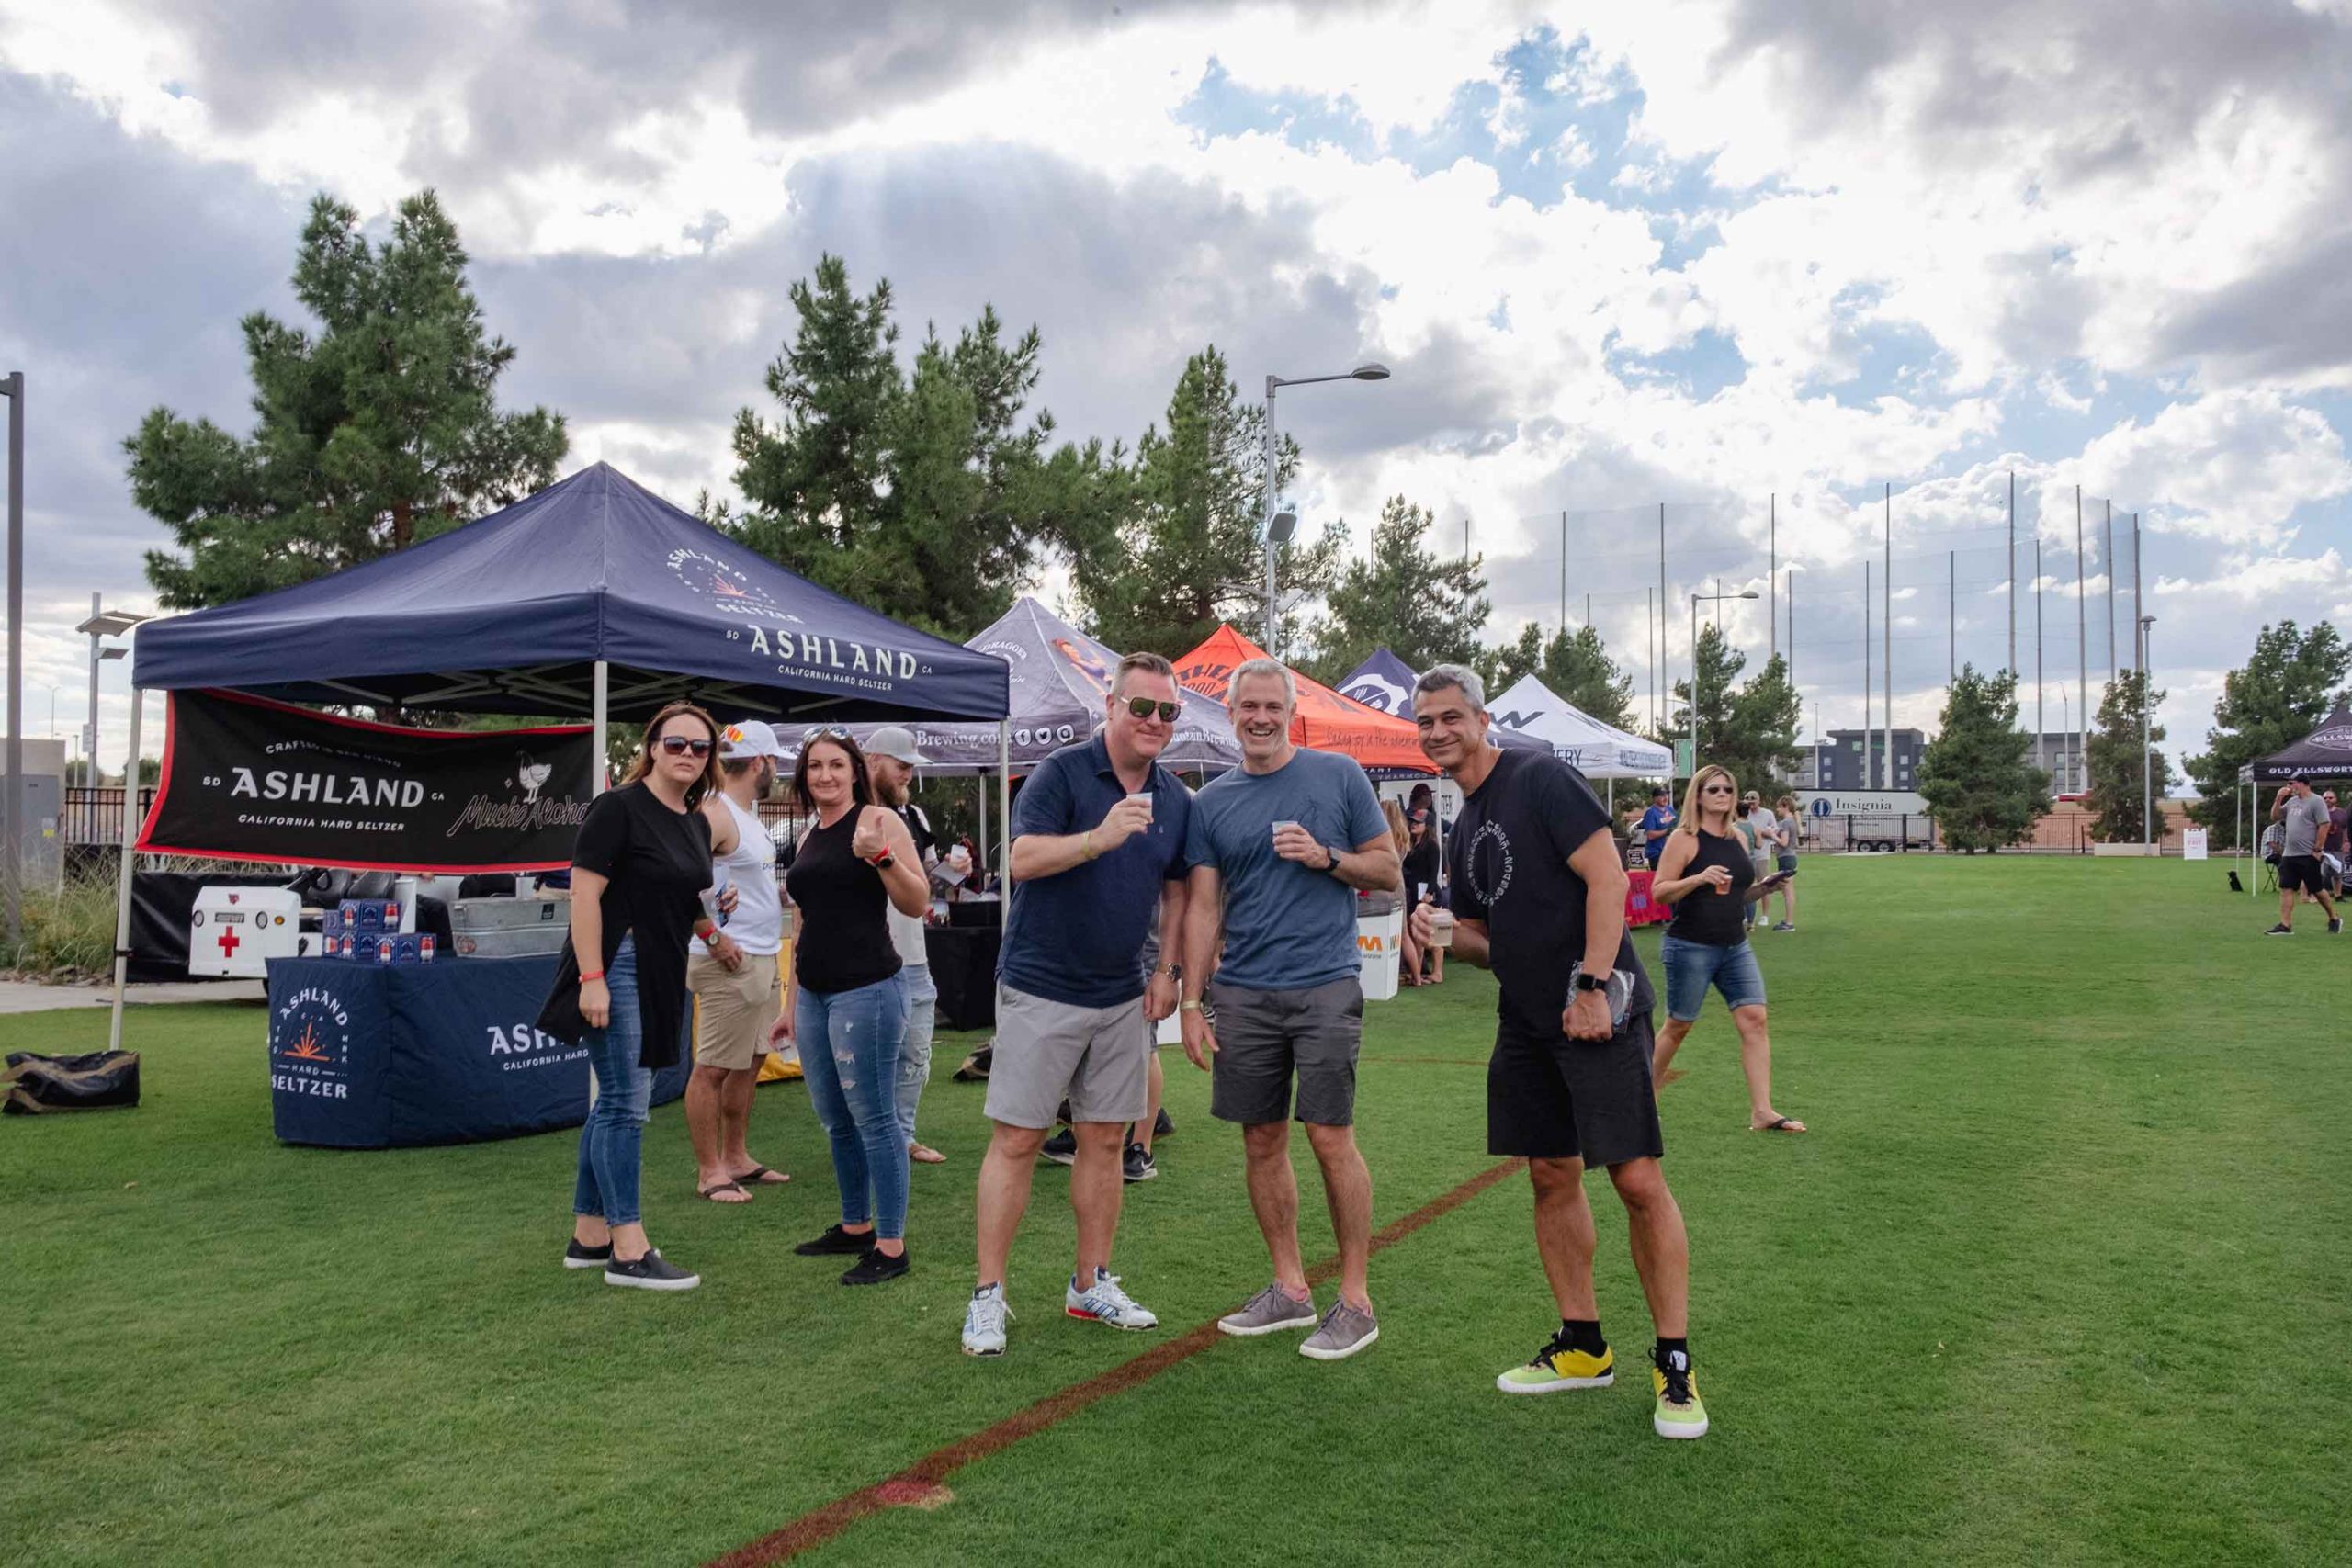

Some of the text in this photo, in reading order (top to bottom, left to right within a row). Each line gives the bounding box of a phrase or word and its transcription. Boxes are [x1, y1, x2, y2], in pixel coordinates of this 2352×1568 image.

[726, 624, 933, 680] SD ASHLAND CA
[778, 664, 893, 691] CALIFORNIA HARD SELTZER
[2269, 766, 2291, 774] OLD
[231, 766, 424, 808] ASHLAND
[431, 792, 445, 802] CA
[446, 794, 527, 837] Mucho
[1836, 797, 1893, 812] Insignia
[238, 813, 405, 832] CALIFORNIA HARD SELTZER
[279, 987, 348, 1027] ASHLAND
[291, 1064, 321, 1077] HARD
[503, 1048, 590, 1072] CALIFORNIA HARD
[271, 1074, 348, 1100] SELTZER
